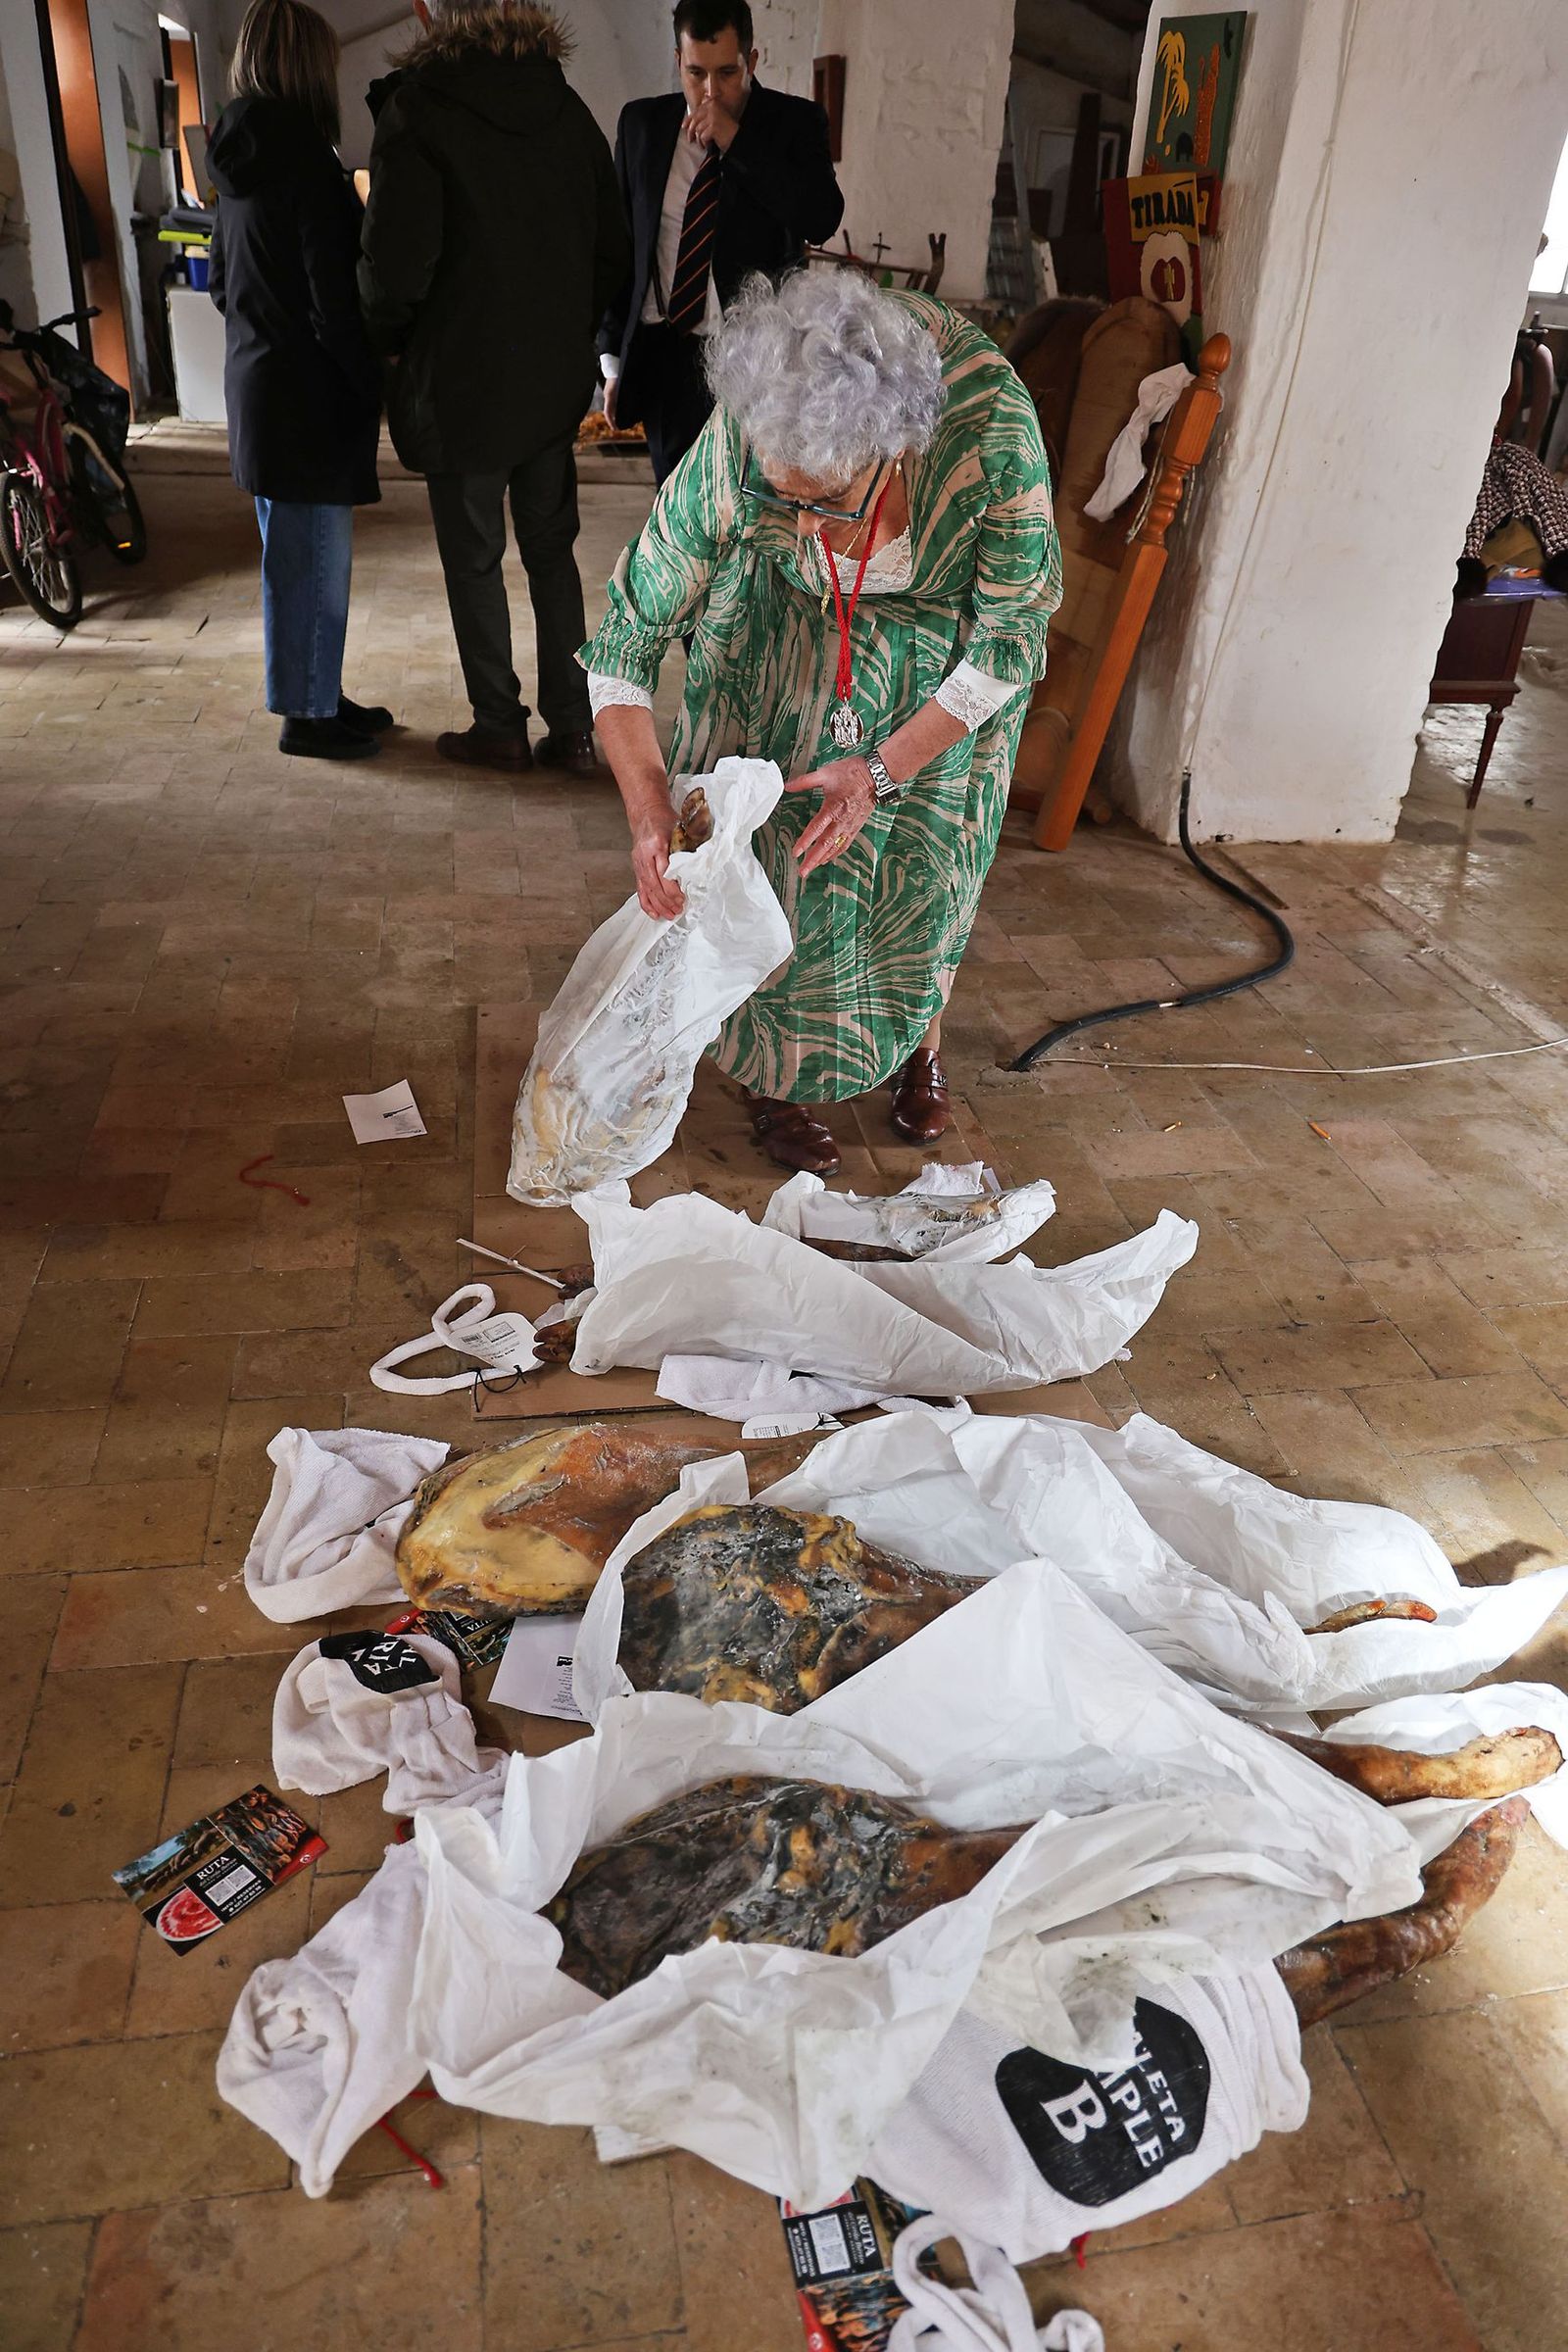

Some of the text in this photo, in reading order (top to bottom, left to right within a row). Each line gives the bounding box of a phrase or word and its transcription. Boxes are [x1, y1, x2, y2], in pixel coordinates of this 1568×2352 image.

[466, 1619, 492, 1631] UTA
[197, 1856, 229, 1880] RUTA
[1040, 2080, 1108, 2145] B
[1133, 2031, 1187, 2143] ALETA
[1094, 2069, 1165, 2169] IPLE
[857, 2214, 877, 2257] RUTA
